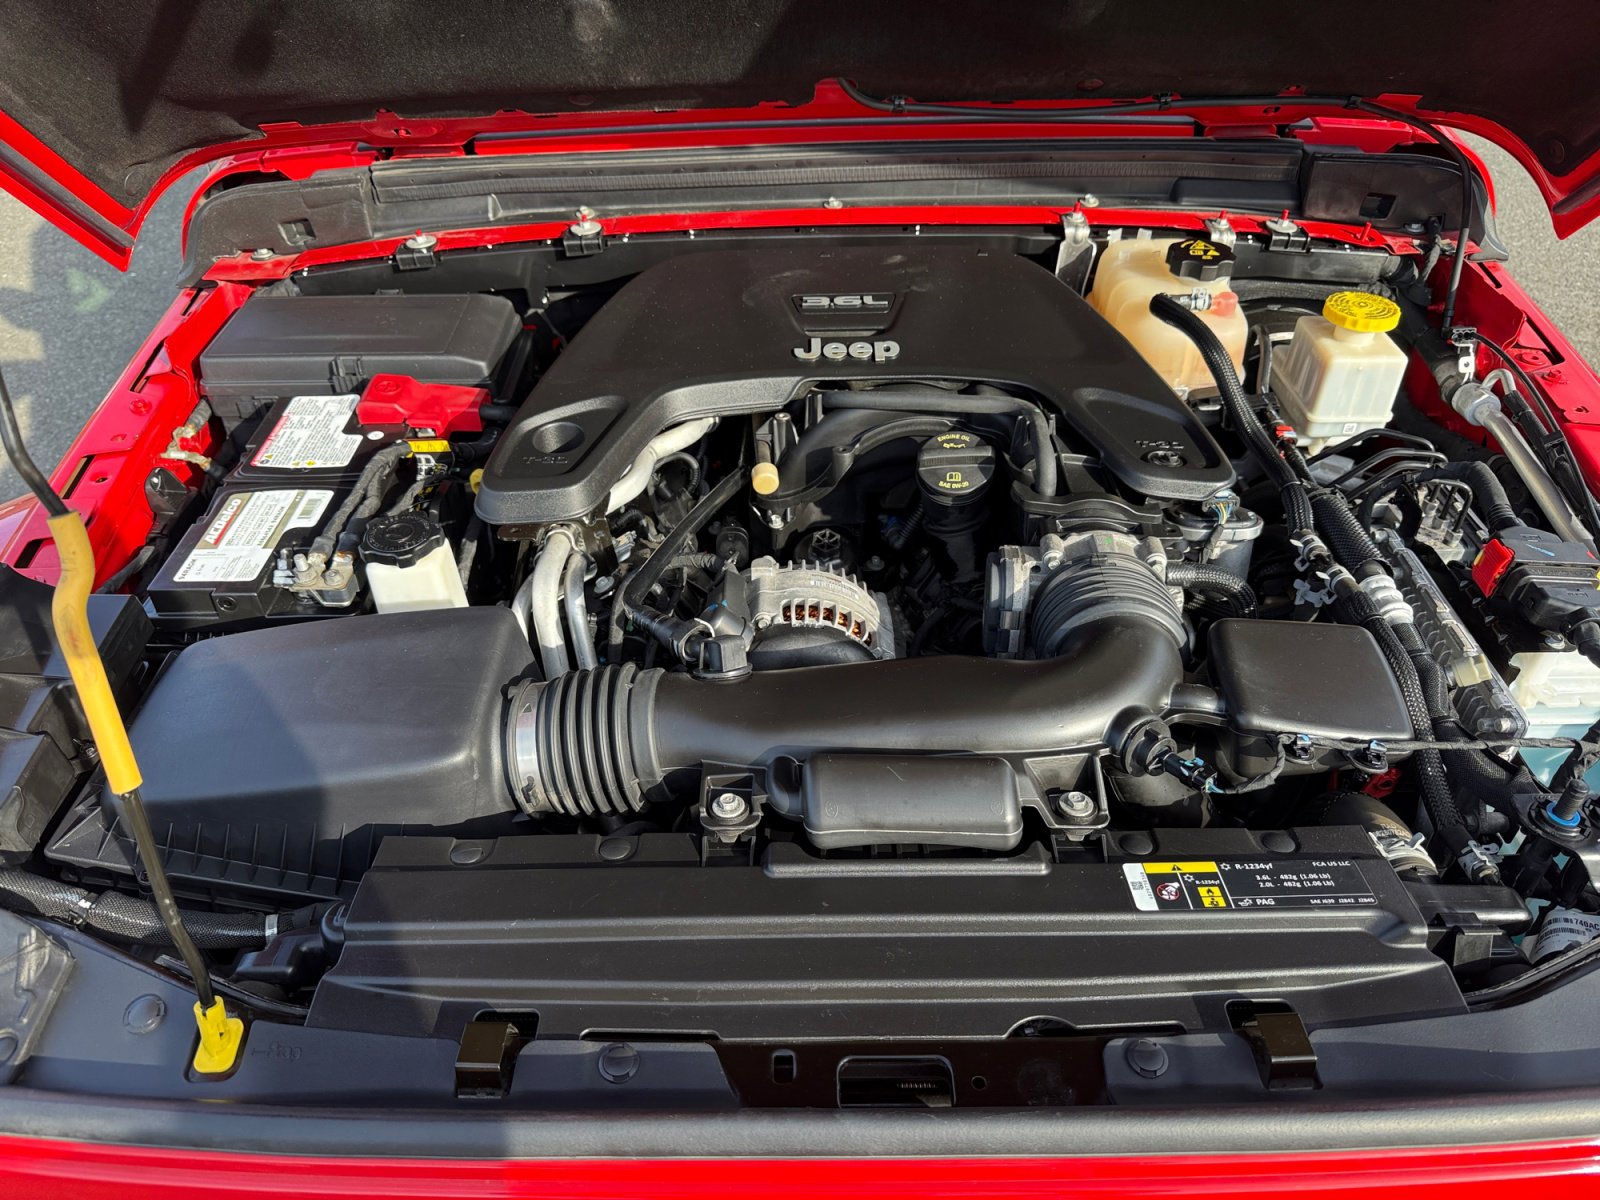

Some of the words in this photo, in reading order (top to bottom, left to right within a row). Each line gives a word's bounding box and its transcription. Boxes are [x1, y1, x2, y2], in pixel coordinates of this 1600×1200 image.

[802, 295, 889, 309] 3.6L
[793, 337, 900, 363] Jeep
[937, 433, 960, 442] ENGINE
[961, 434, 971, 442] OIL
[939, 480, 951, 488] SAE
[204, 498, 242, 545] ACDelco
[1235, 862, 1273, 871] R-1234yf
[1300, 873, 1316, 881] (1.06
[1283, 881, 1302, 889] 482g
[1303, 880, 1320, 888] (1.06
[1255, 898, 1275, 906] PAG
